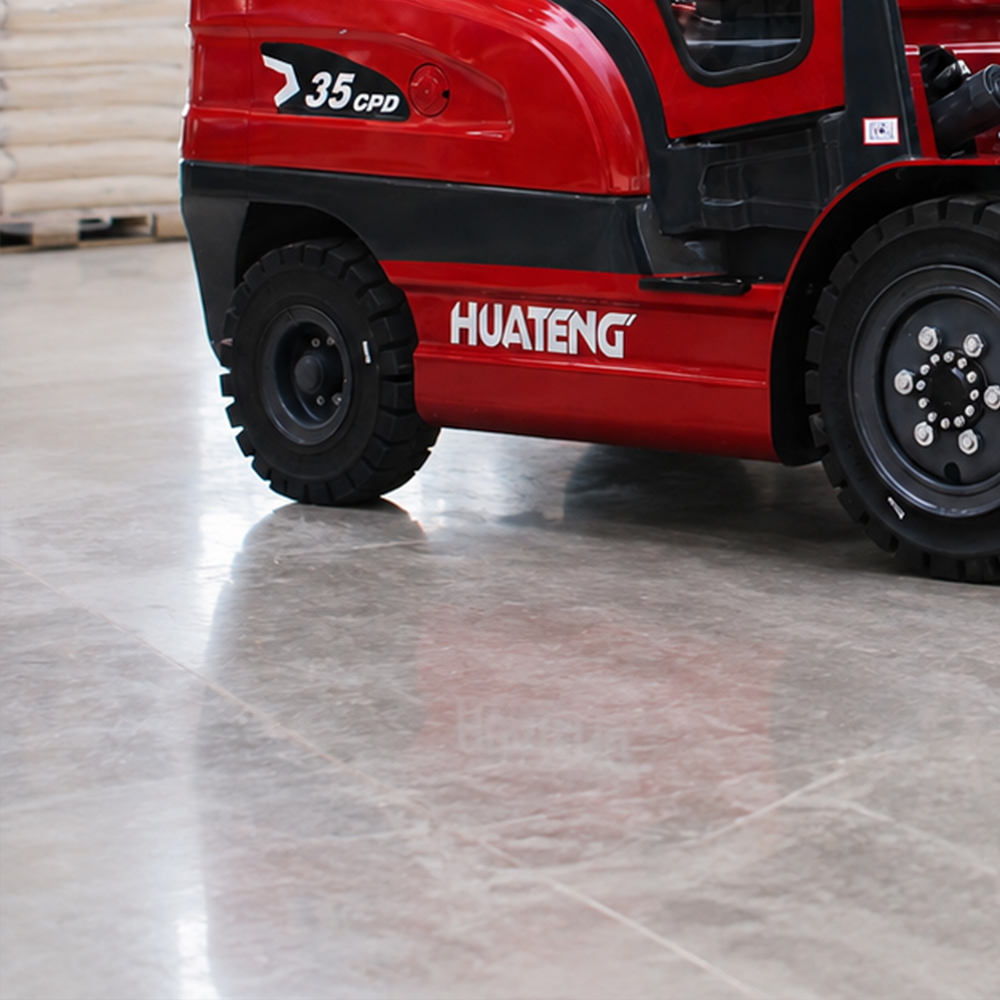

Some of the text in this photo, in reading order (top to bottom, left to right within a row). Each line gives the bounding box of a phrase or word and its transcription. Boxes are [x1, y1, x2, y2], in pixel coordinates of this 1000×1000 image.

[305, 71, 400, 113] 35 CPD
[450, 301, 637, 359] HUATENG
